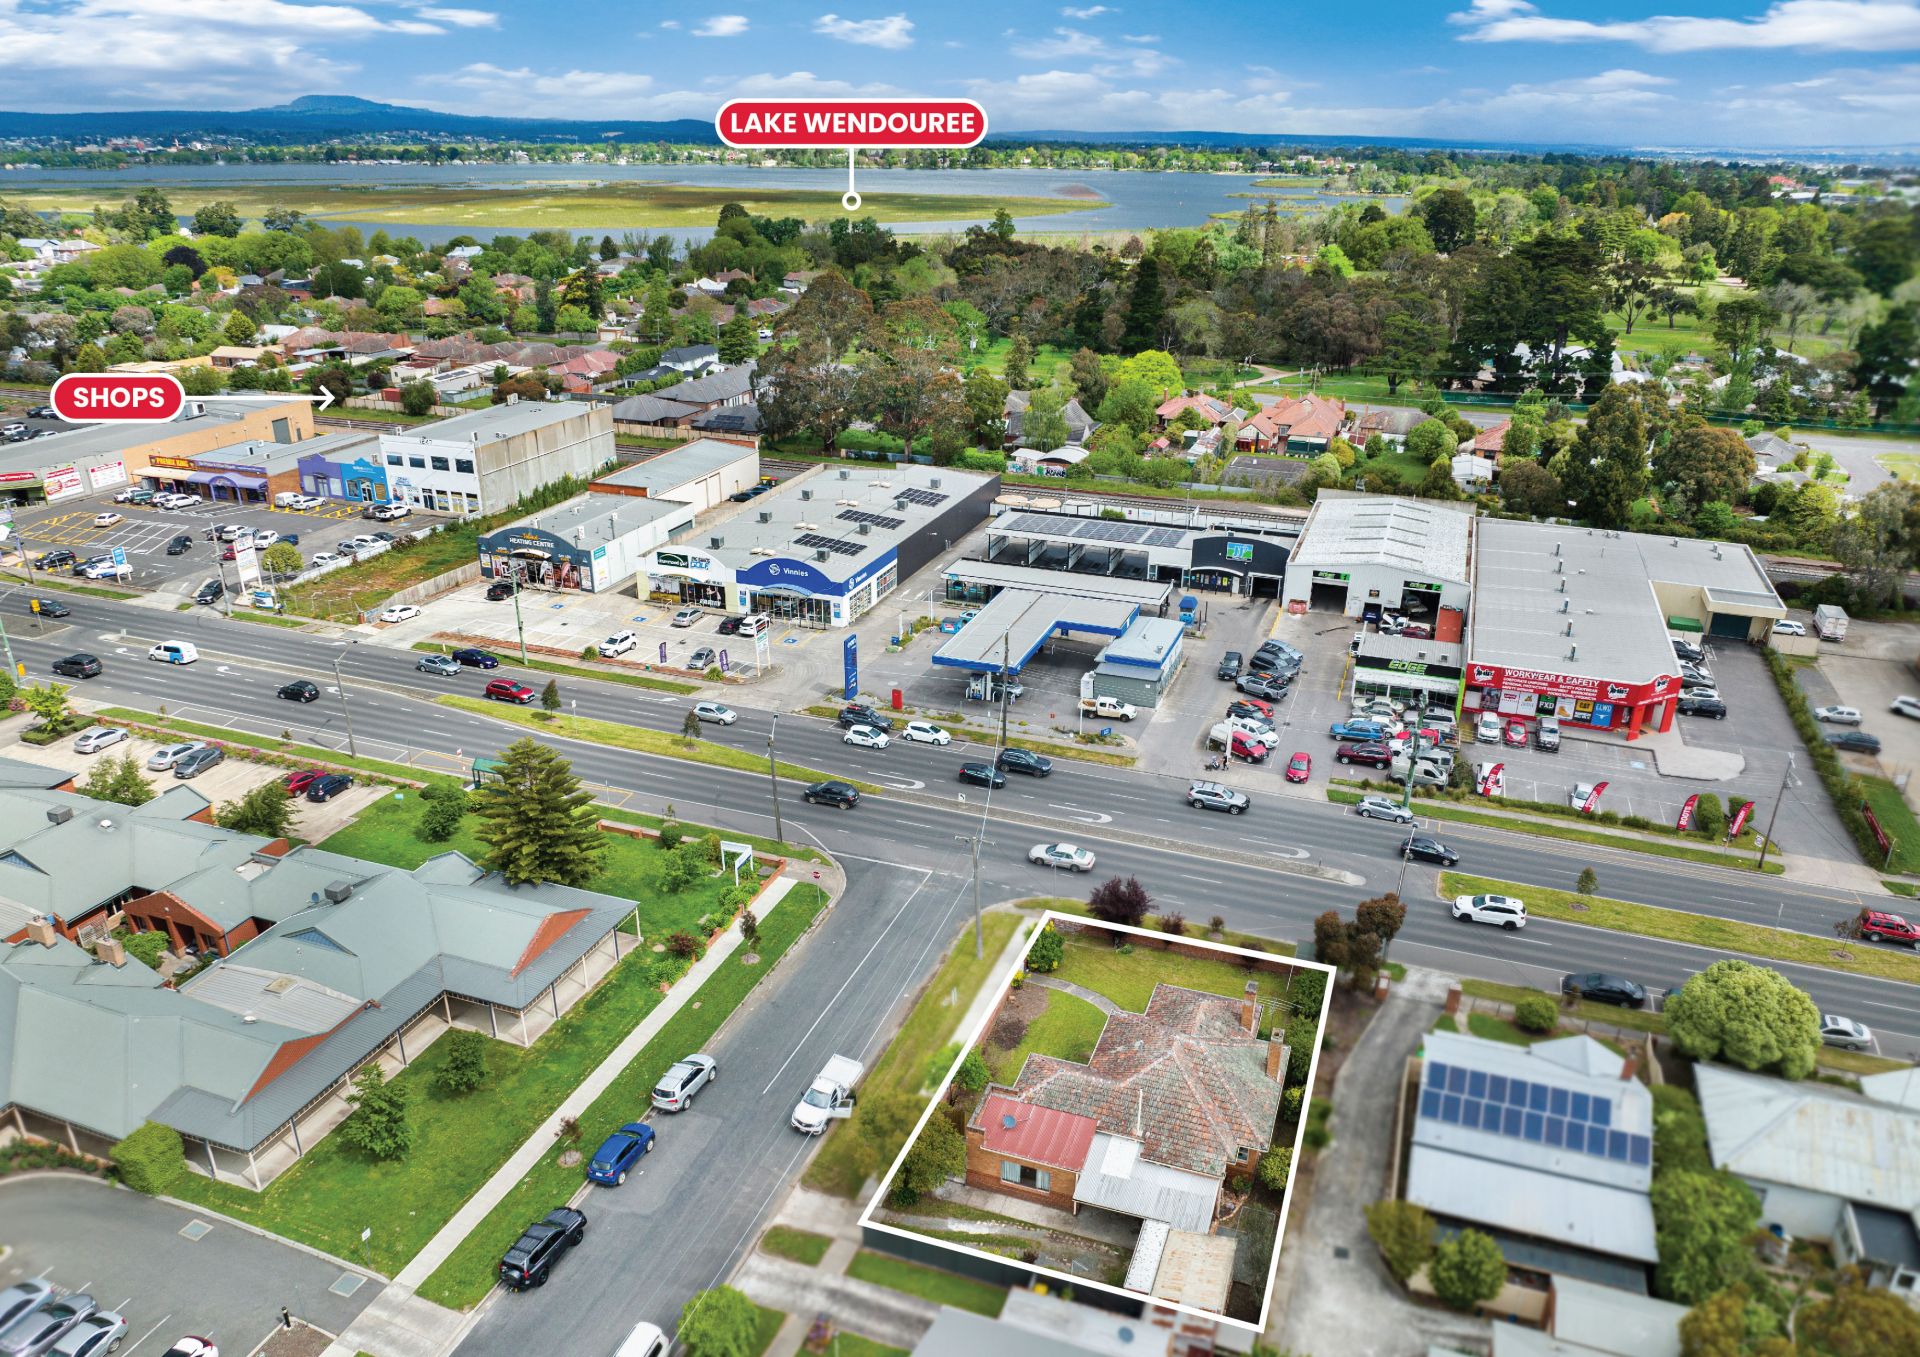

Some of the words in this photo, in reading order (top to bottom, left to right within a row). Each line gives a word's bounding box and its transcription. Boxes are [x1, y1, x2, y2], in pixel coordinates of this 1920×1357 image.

[509, 537, 532, 546] HEATING
[532, 539, 555, 548] CENTRE
[783, 567, 809, 577] Vinnies
[1388, 660, 1428, 672] EDGE
[1505, 668, 1557, 682] WORKWEAR
[1557, 675, 1564, 683] &
[1566, 676, 1600, 687] SAFETY
[1538, 701, 1555, 709] FXD
[1487, 774, 1497, 789] OPEN
[1679, 805, 1692, 825] BOOTS
